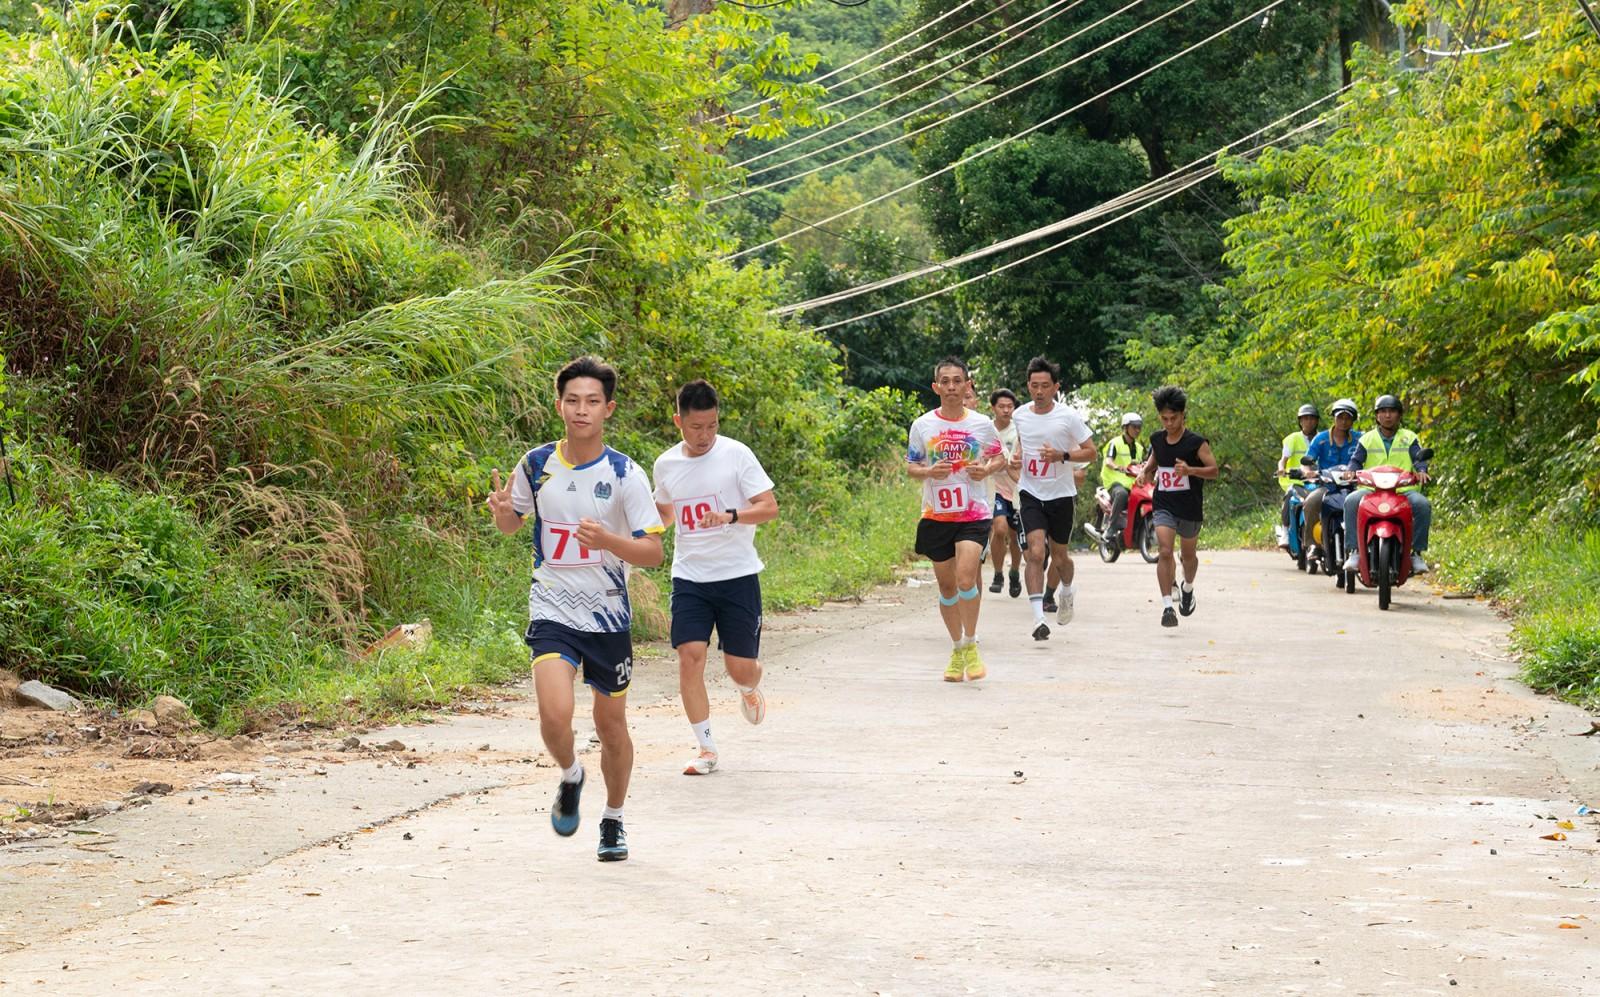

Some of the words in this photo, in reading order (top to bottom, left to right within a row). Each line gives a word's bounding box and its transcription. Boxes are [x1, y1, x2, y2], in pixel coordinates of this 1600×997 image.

[943, 451, 963, 460] RUN
[1028, 459, 1050, 477] 47
[1162, 471, 1184, 488] 82
[938, 487, 963, 509] 91
[615, 656, 632, 686] 26
